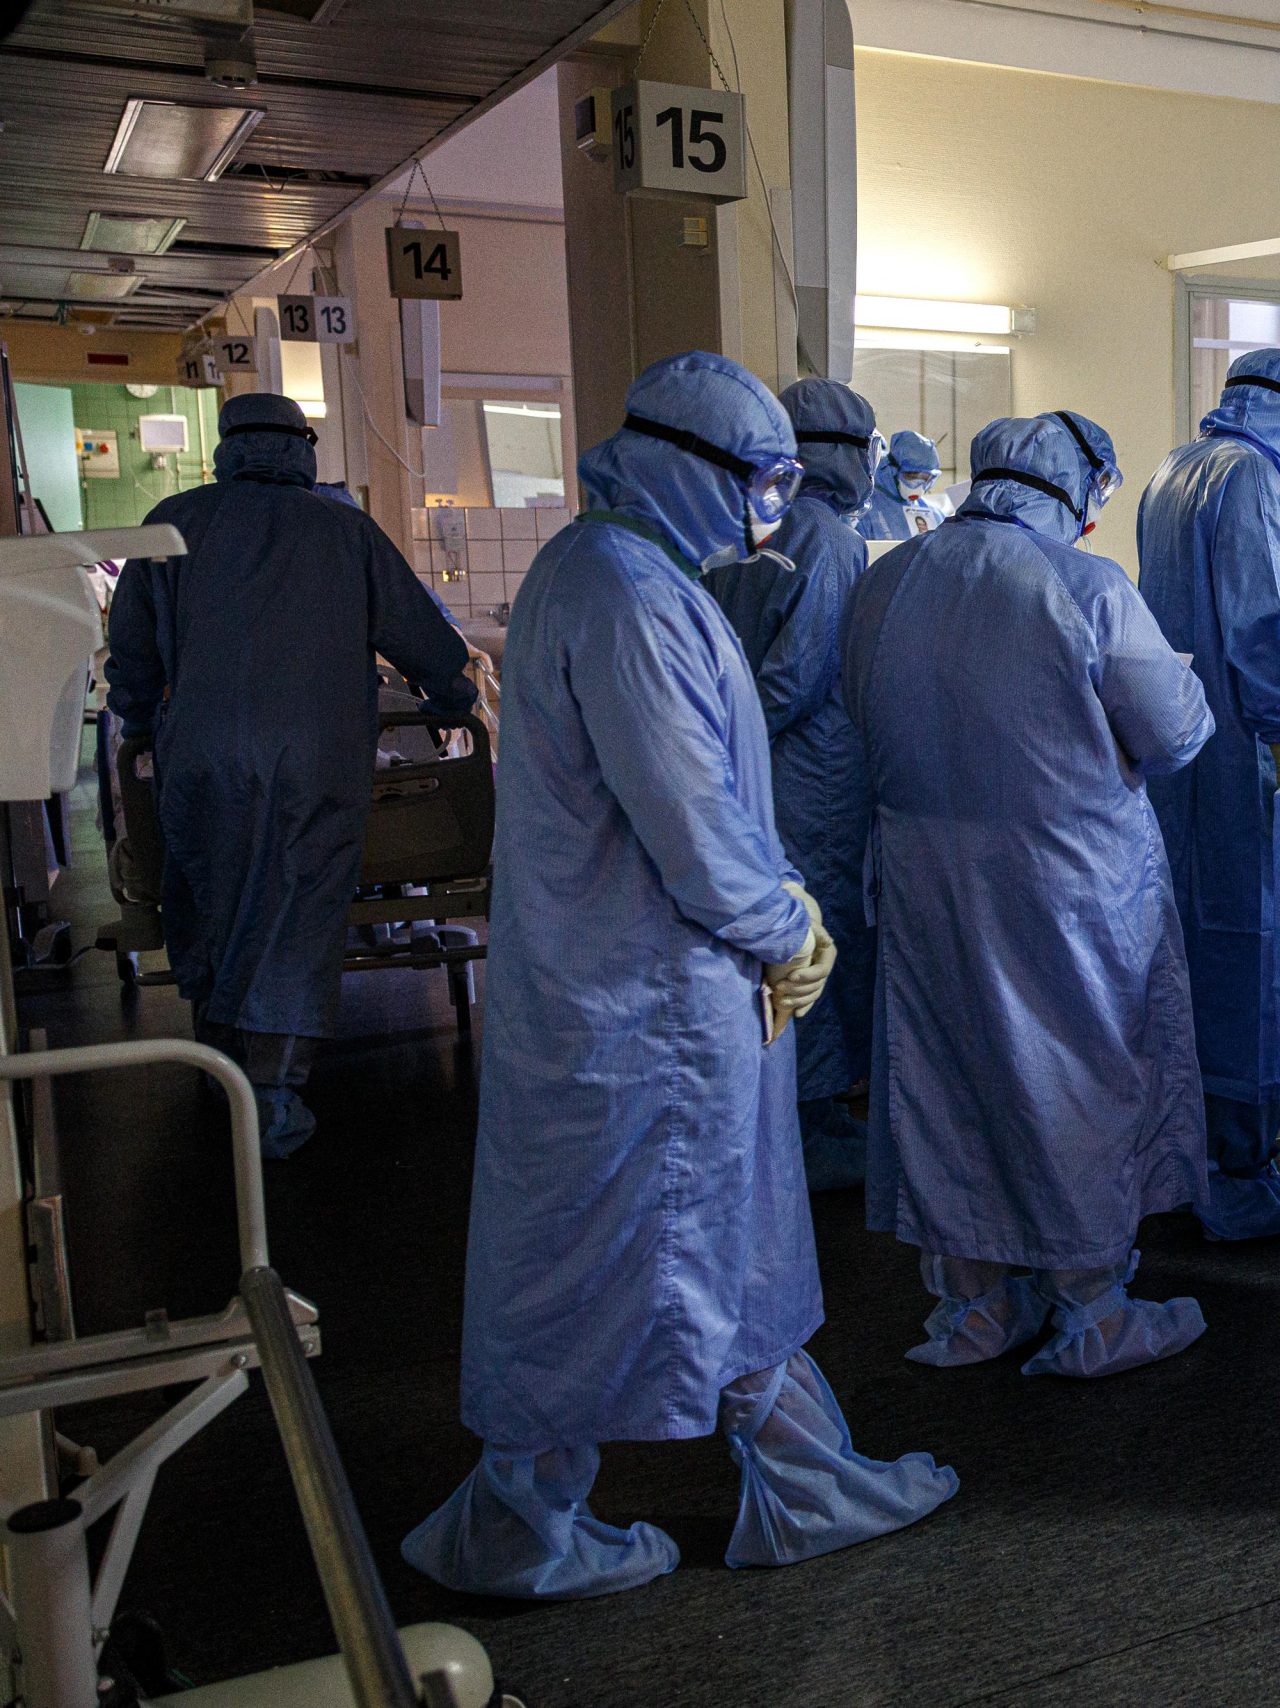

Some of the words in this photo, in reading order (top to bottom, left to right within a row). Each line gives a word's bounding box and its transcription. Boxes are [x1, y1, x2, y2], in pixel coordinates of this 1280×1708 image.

[615, 105, 635, 170] 15
[656, 106, 727, 173] 15
[403, 242, 452, 281] 14
[284, 304, 309, 333] 13
[320, 306, 346, 334] 13
[222, 343, 250, 364] 12
